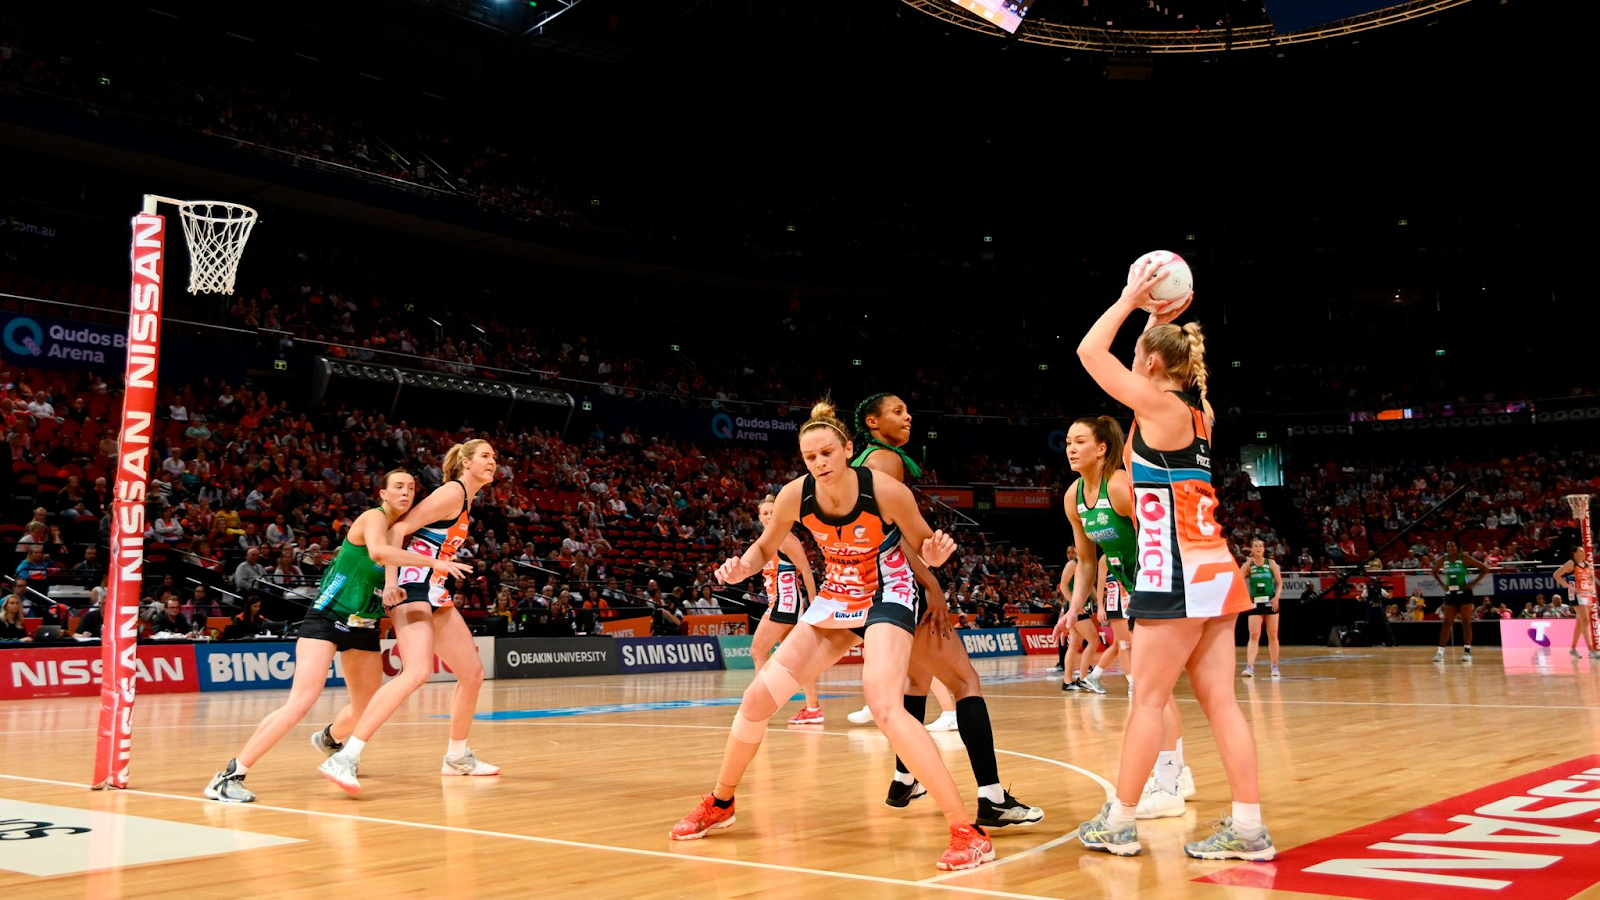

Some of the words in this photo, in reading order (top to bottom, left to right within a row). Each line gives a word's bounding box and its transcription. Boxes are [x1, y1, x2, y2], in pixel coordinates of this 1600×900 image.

[129, 217, 162, 388] NISSAN
[49, 325, 112, 346] Qudos
[48, 343, 105, 364] Arena
[735, 416, 770, 429] Qudos
[771, 419, 798, 431] Bank
[736, 430, 768, 441] Arena
[120, 411, 151, 581] NISSAN
[829, 556, 860, 565] NISSAN
[1142, 528, 1164, 587] HCF
[1499, 577, 1566, 591] SAMSU
[782, 586, 794, 612] HCF
[962, 634, 996, 654] BING
[996, 633, 1019, 652] LEE
[1025, 634, 1058, 649] NISS
[521, 652, 553, 664] DEAKIN
[553, 651, 607, 663] UNIVERSITY
[622, 642, 715, 667] SAMSUNG
[724, 647, 751, 658] SUNCO
[208, 651, 296, 683] BING
